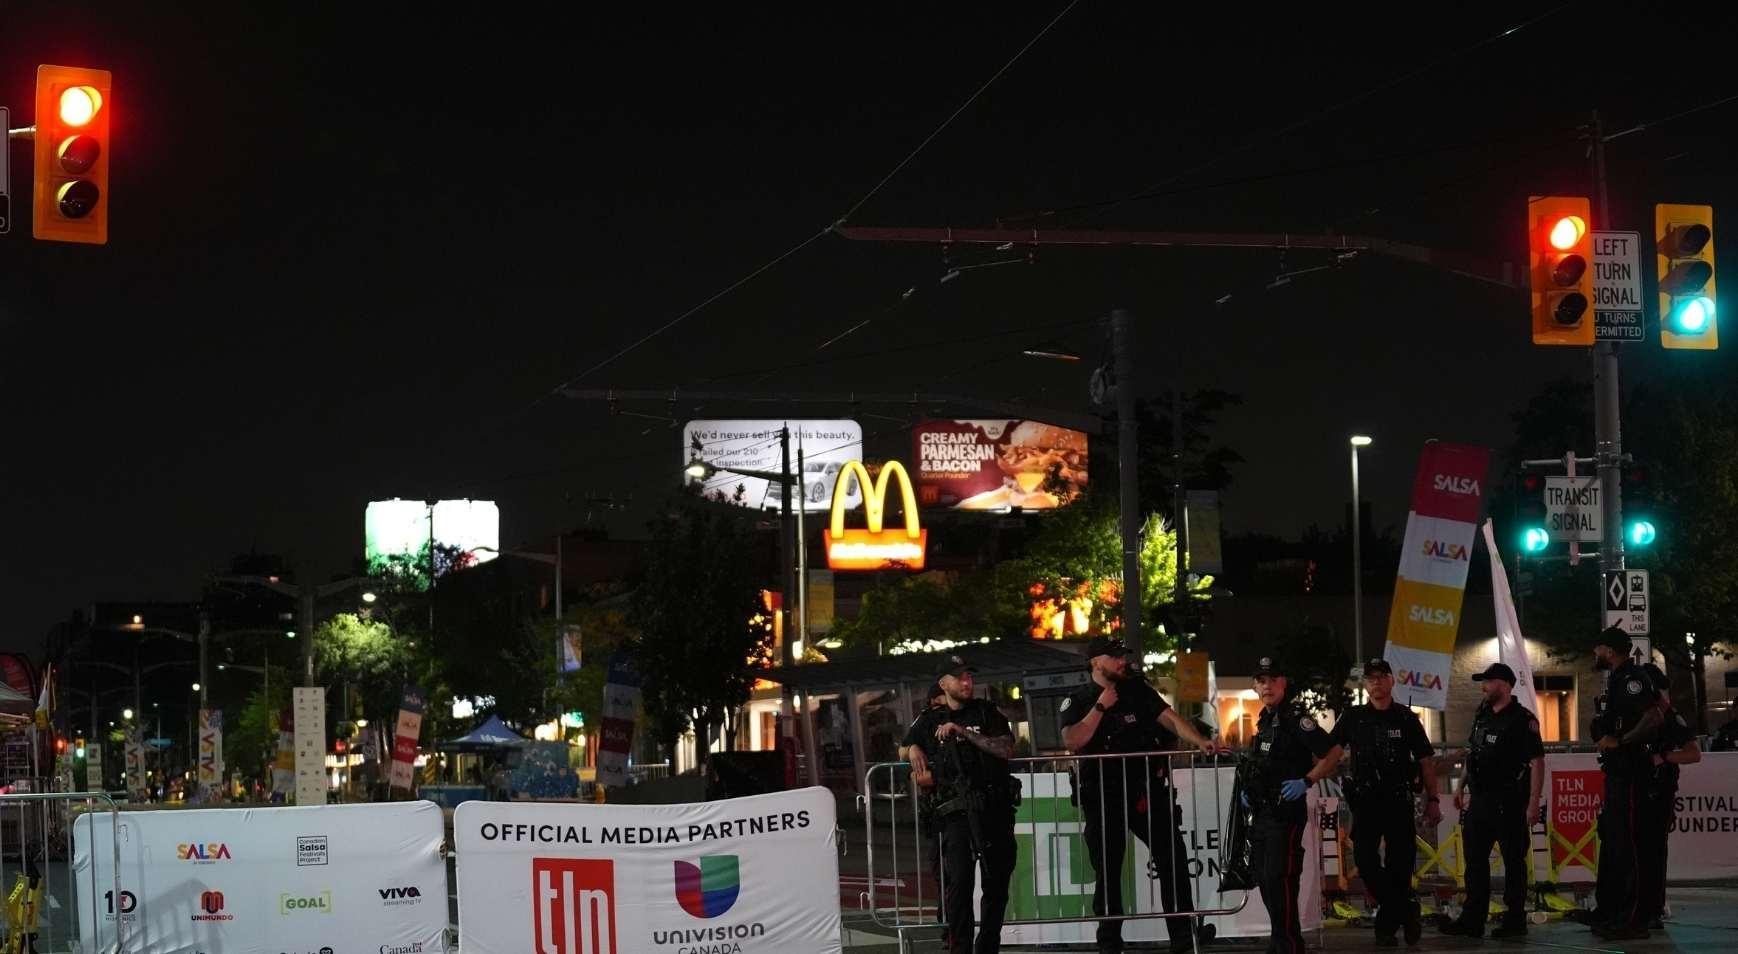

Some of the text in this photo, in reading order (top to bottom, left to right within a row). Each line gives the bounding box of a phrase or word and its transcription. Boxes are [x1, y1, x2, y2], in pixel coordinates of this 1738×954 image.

[1594, 239, 1628, 256] LEFT
[1594, 263, 1631, 281] TURN
[1604, 313, 1636, 323] TURNS
[1595, 327, 1642, 337] ERMITTED
[720, 431, 750, 440] never
[816, 430, 856, 441] beauty.
[920, 432, 978, 444] CREAMY
[703, 448, 724, 456] ailed
[920, 444, 995, 460] PARMESAN
[920, 460, 982, 472] & BACON
[1433, 474, 1480, 496] SALSA
[1548, 488, 1599, 506] TRANSIT
[1553, 513, 1597, 532] SIGNAL
[1423, 540, 1468, 561] SALSA
[1408, 604, 1455, 626] SALSA
[1631, 614, 1645, 622] THIS
[1629, 624, 1646, 632] LANE
[1398, 668, 1442, 690] SALSA
[1557, 778, 1584, 791] TLN
[1558, 794, 1601, 807] MEDIA
[1673, 796, 1738, 812] STIVAL
[1558, 810, 1598, 823] GROU
[480, 810, 811, 844] OFFICIAL MEDIA PARTNERS
[176, 843, 231, 860] SALSA
[539, 870, 609, 954] tln
